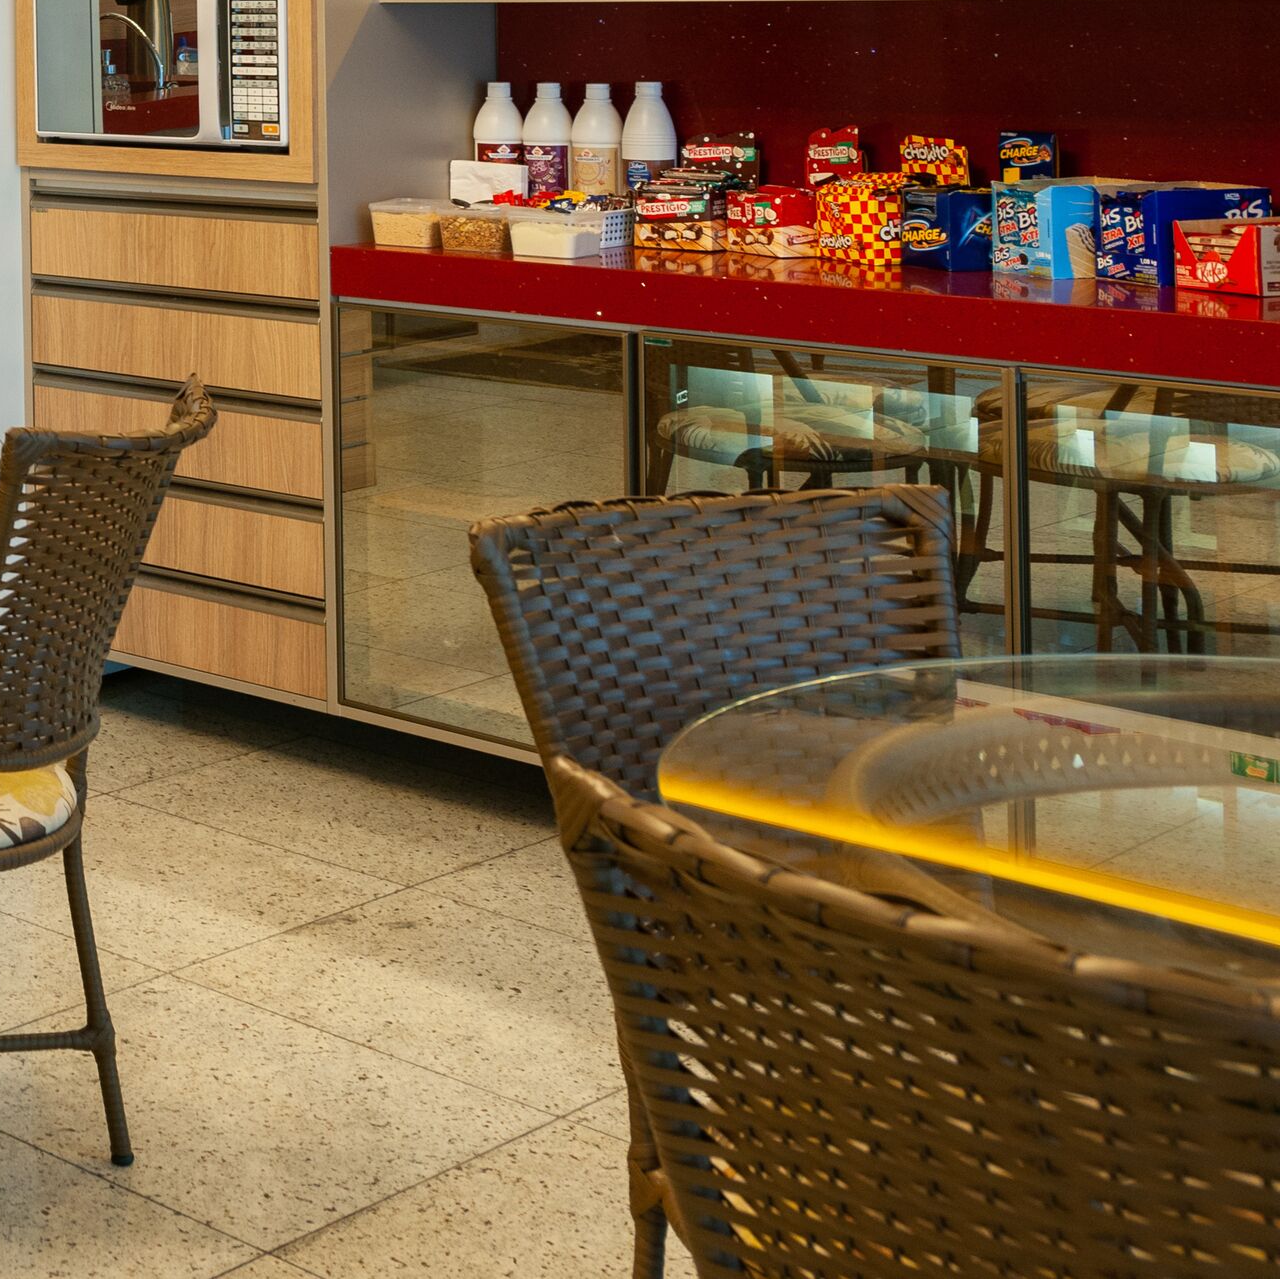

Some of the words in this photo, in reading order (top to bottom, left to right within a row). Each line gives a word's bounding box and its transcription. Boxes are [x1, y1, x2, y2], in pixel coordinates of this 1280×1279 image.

[688, 146, 731, 158] PRESTIGIO
[813, 148, 848, 158] PRESTIGIO
[1000, 146, 1039, 159] CHARGE
[640, 203, 690, 216] PRESTIGIO
[902, 229, 940, 242] CHARGE
